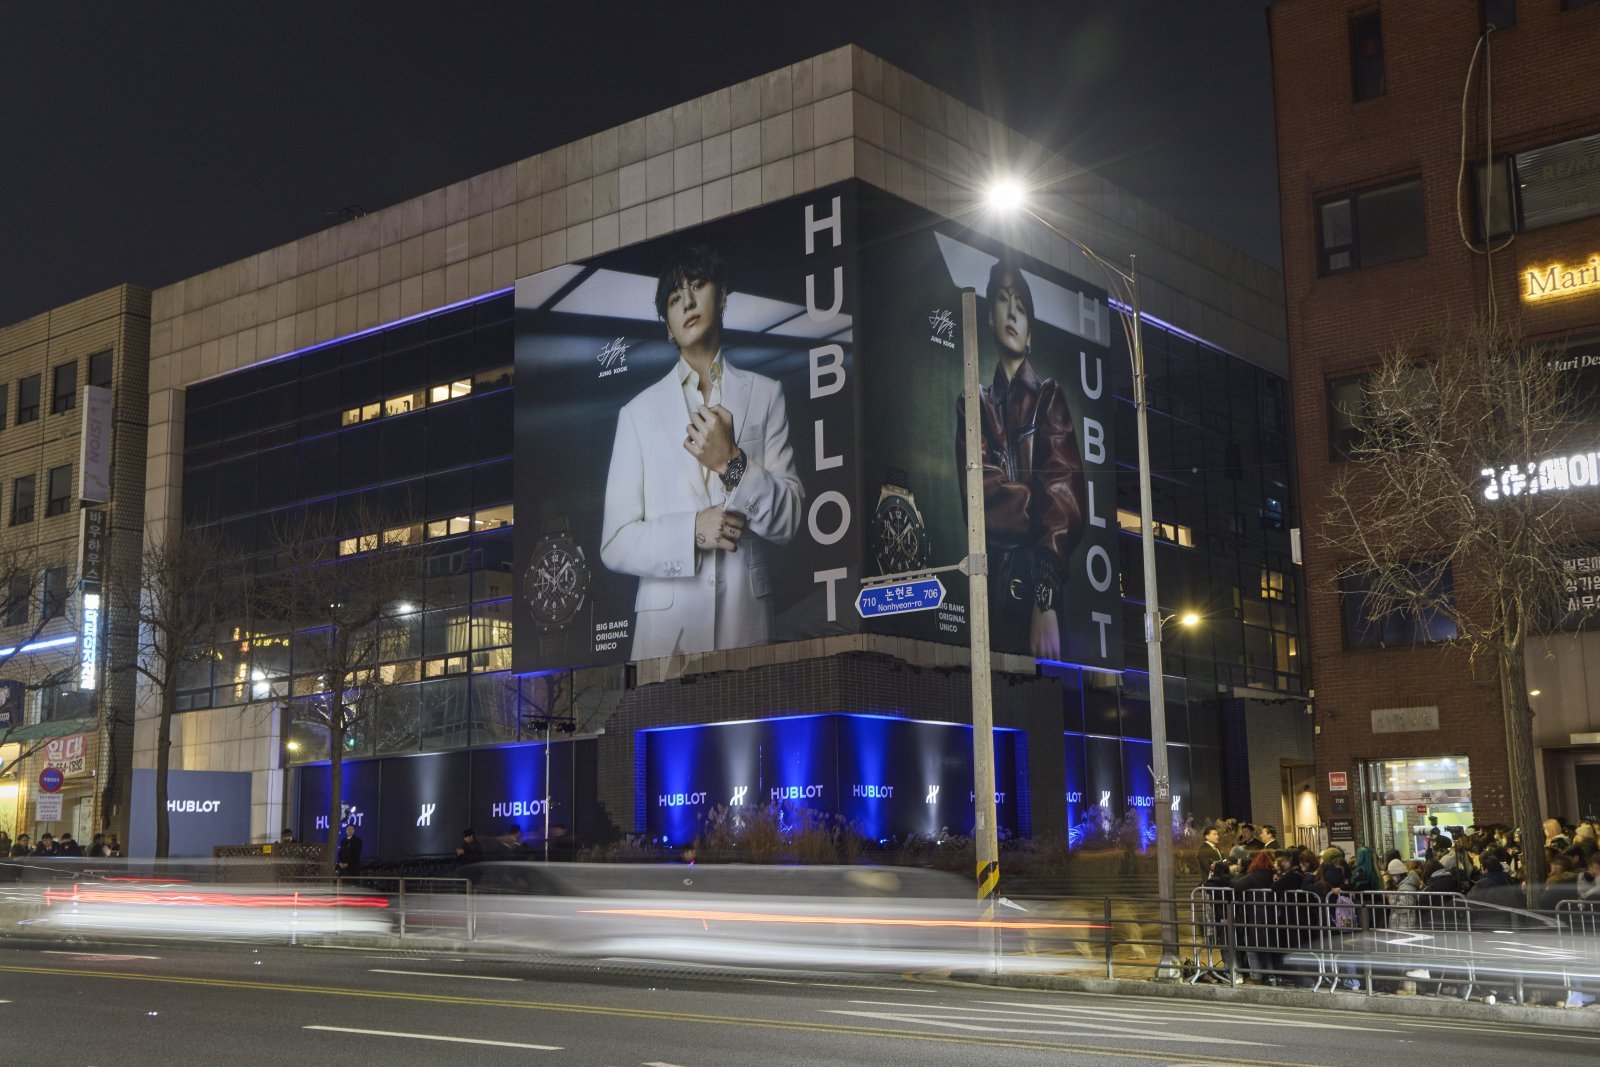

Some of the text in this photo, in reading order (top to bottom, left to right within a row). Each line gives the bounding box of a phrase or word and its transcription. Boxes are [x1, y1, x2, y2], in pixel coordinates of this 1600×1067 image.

[1527, 258, 1600, 296] Mari
[930, 335, 955, 349] JUNG KOOK
[1581, 355, 1600, 367] De
[598, 365, 628, 379] JUNG KOOK
[804, 195, 851, 622] HUBLOT
[1078, 290, 1112, 659] HUBLOT
[86, 511, 103, 579] 바우하우스
[885, 586, 915, 602] 논현로
[923, 588, 938, 599] 706
[862, 597, 876, 608] 710
[878, 600, 922, 612] Nonhyeon-ro
[948, 603, 965, 613] BANG
[1568, 595, 1600, 612] 사무
[938, 612, 966, 624] ORIGINAL
[596, 620, 628, 632] BIG BANG
[939, 623, 958, 633] UNICO
[596, 631, 628, 642] ORIGINAL
[596, 642, 618, 652] UNICO
[48, 736, 84, 761] 임대
[770, 784, 823, 801] HUBLOT
[853, 784, 893, 798] HUBLOT
[659, 791, 706, 807] HUBLOT
[1127, 795, 1155, 807] HUBLOT
[167, 800, 220, 813] HUBLOT
[492, 799, 547, 818] HUBLOT
[316, 812, 364, 830] HUOT
